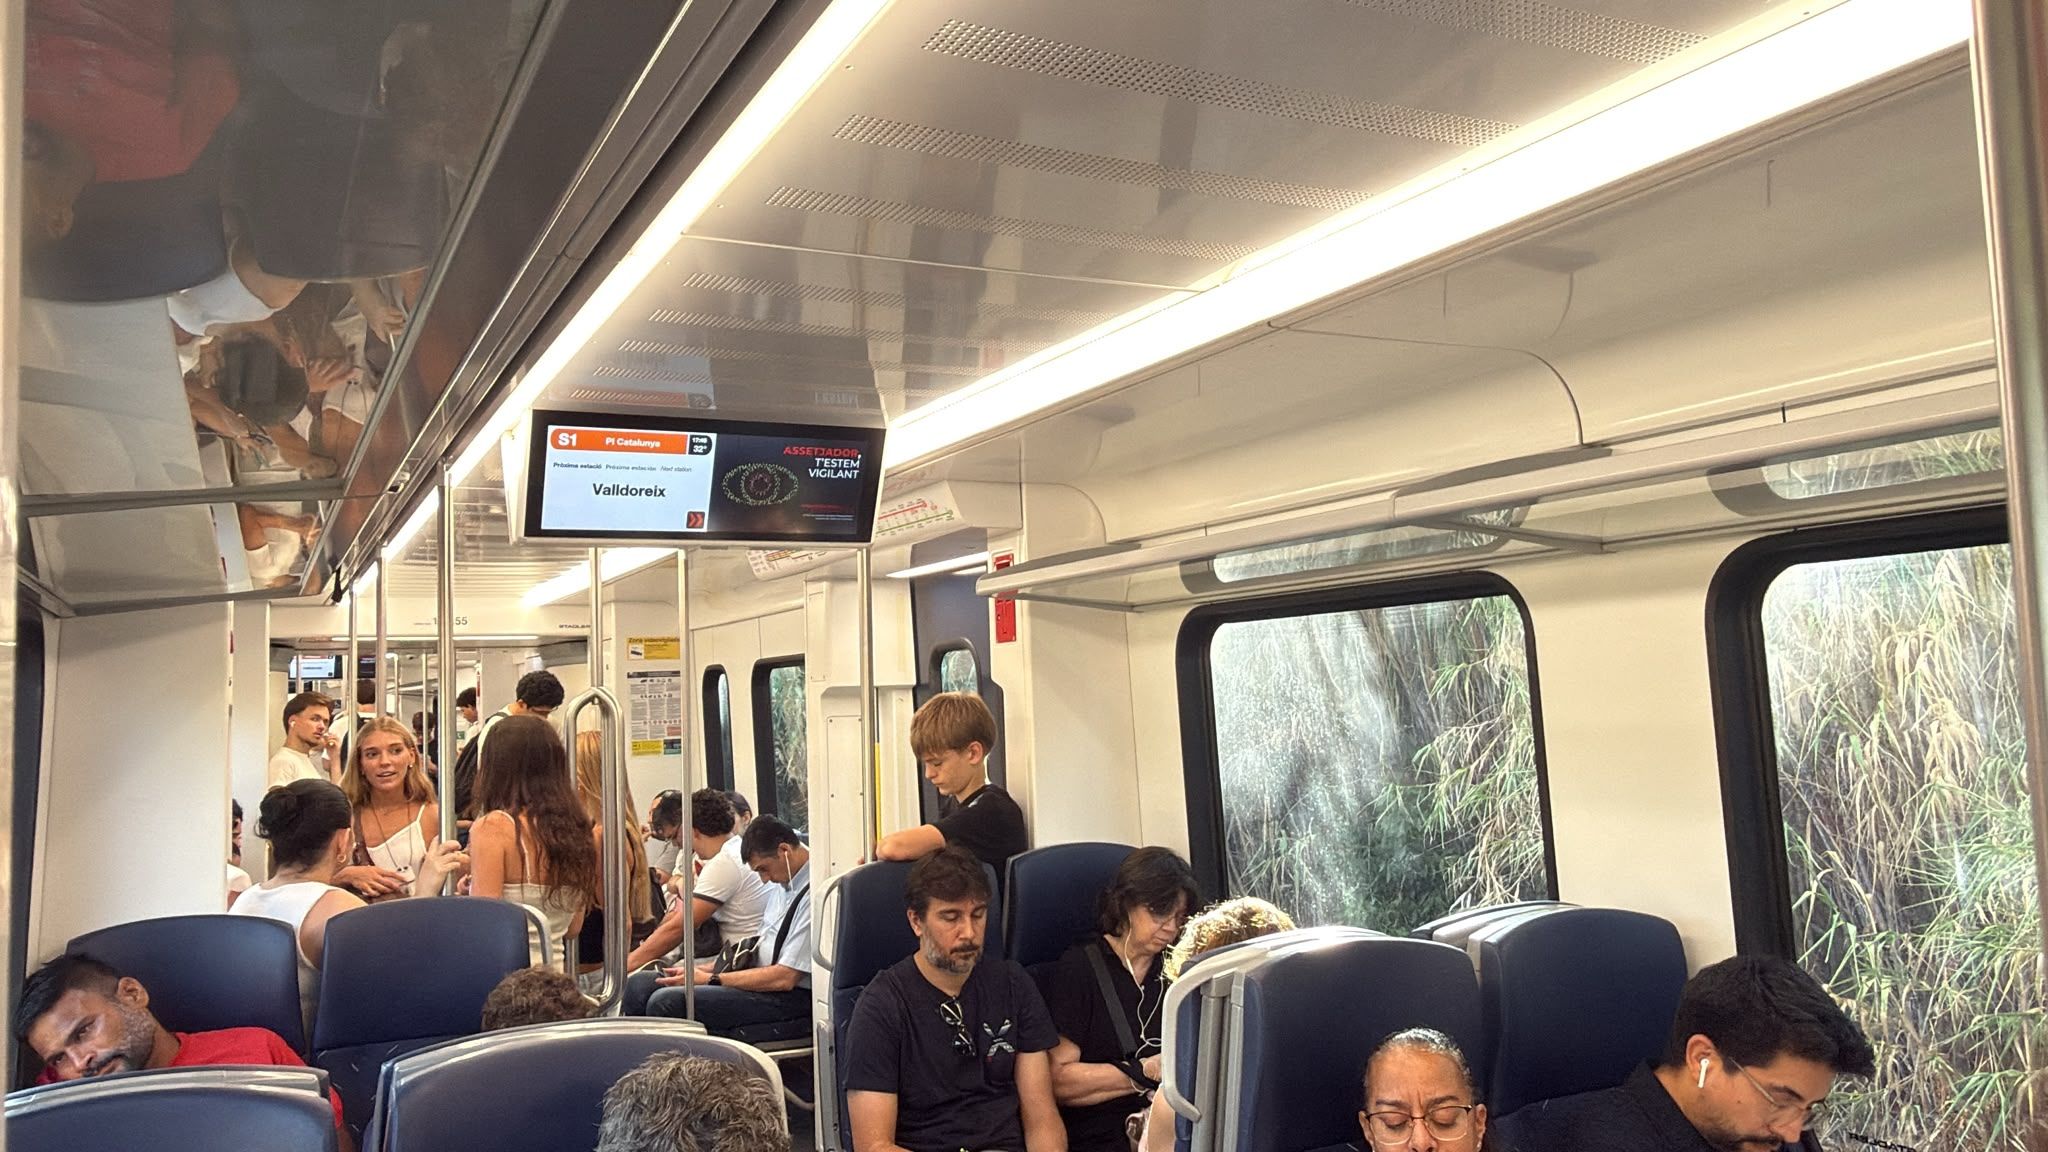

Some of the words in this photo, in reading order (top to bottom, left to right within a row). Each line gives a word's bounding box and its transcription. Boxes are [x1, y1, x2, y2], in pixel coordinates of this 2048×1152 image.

[558, 433, 577, 446] S1
[616, 439, 661, 448] Catalunya
[815, 458, 860, 468] T'ESTEM
[808, 468, 860, 479] VIGILANT
[592, 483, 666, 497] Valldoreix
